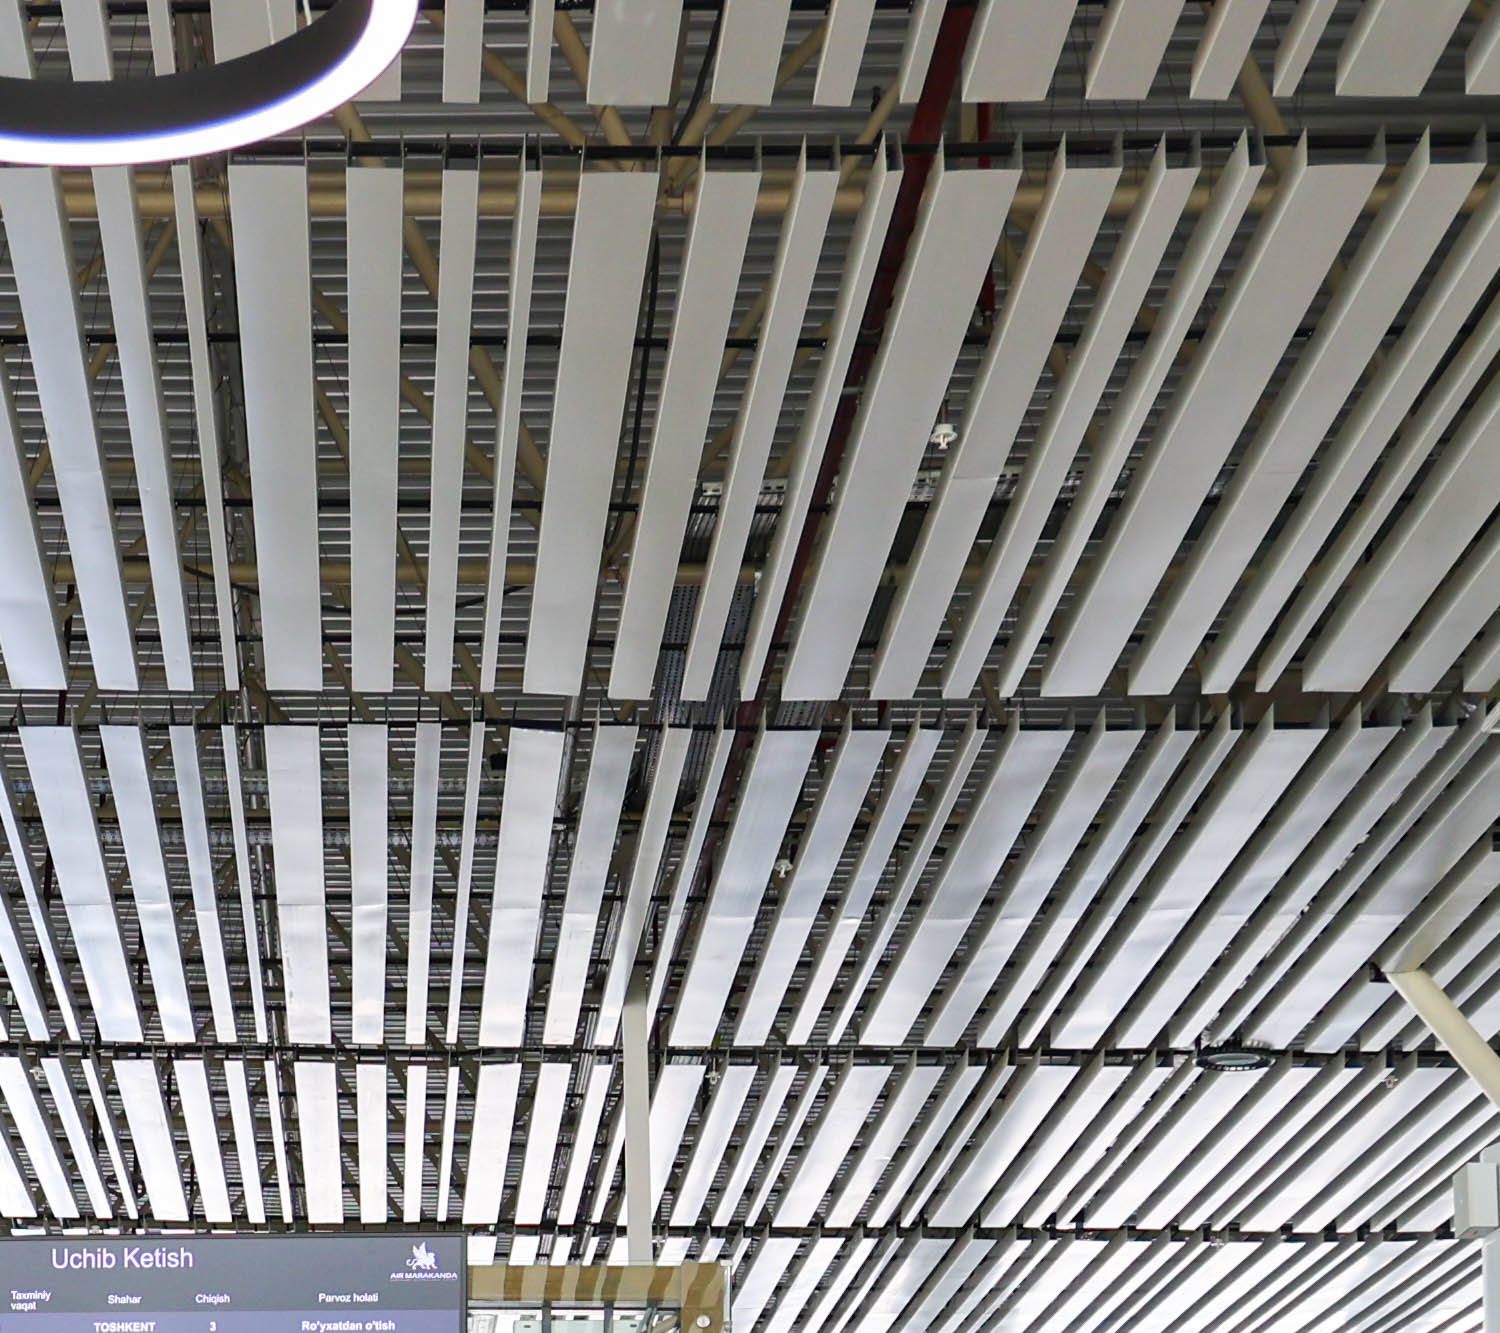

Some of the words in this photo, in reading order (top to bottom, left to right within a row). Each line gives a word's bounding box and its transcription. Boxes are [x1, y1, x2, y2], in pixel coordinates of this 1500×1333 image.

[51, 1248, 116, 1269] Uchib
[124, 1247, 193, 1268] Ketish
[390, 1272, 404, 1280] AIR
[405, 1272, 458, 1280] MARAKANDA
[10, 1290, 52, 1302] Taxminiy
[107, 1294, 142, 1304] Shahar
[195, 1294, 231, 1305] Chiqish
[318, 1293, 351, 1303] Parvoz
[353, 1293, 379, 1303] holati
[10, 1302, 37, 1312] vaqat
[93, 1322, 156, 1332] TOSHKENT
[209, 1321, 217, 1332] 3
